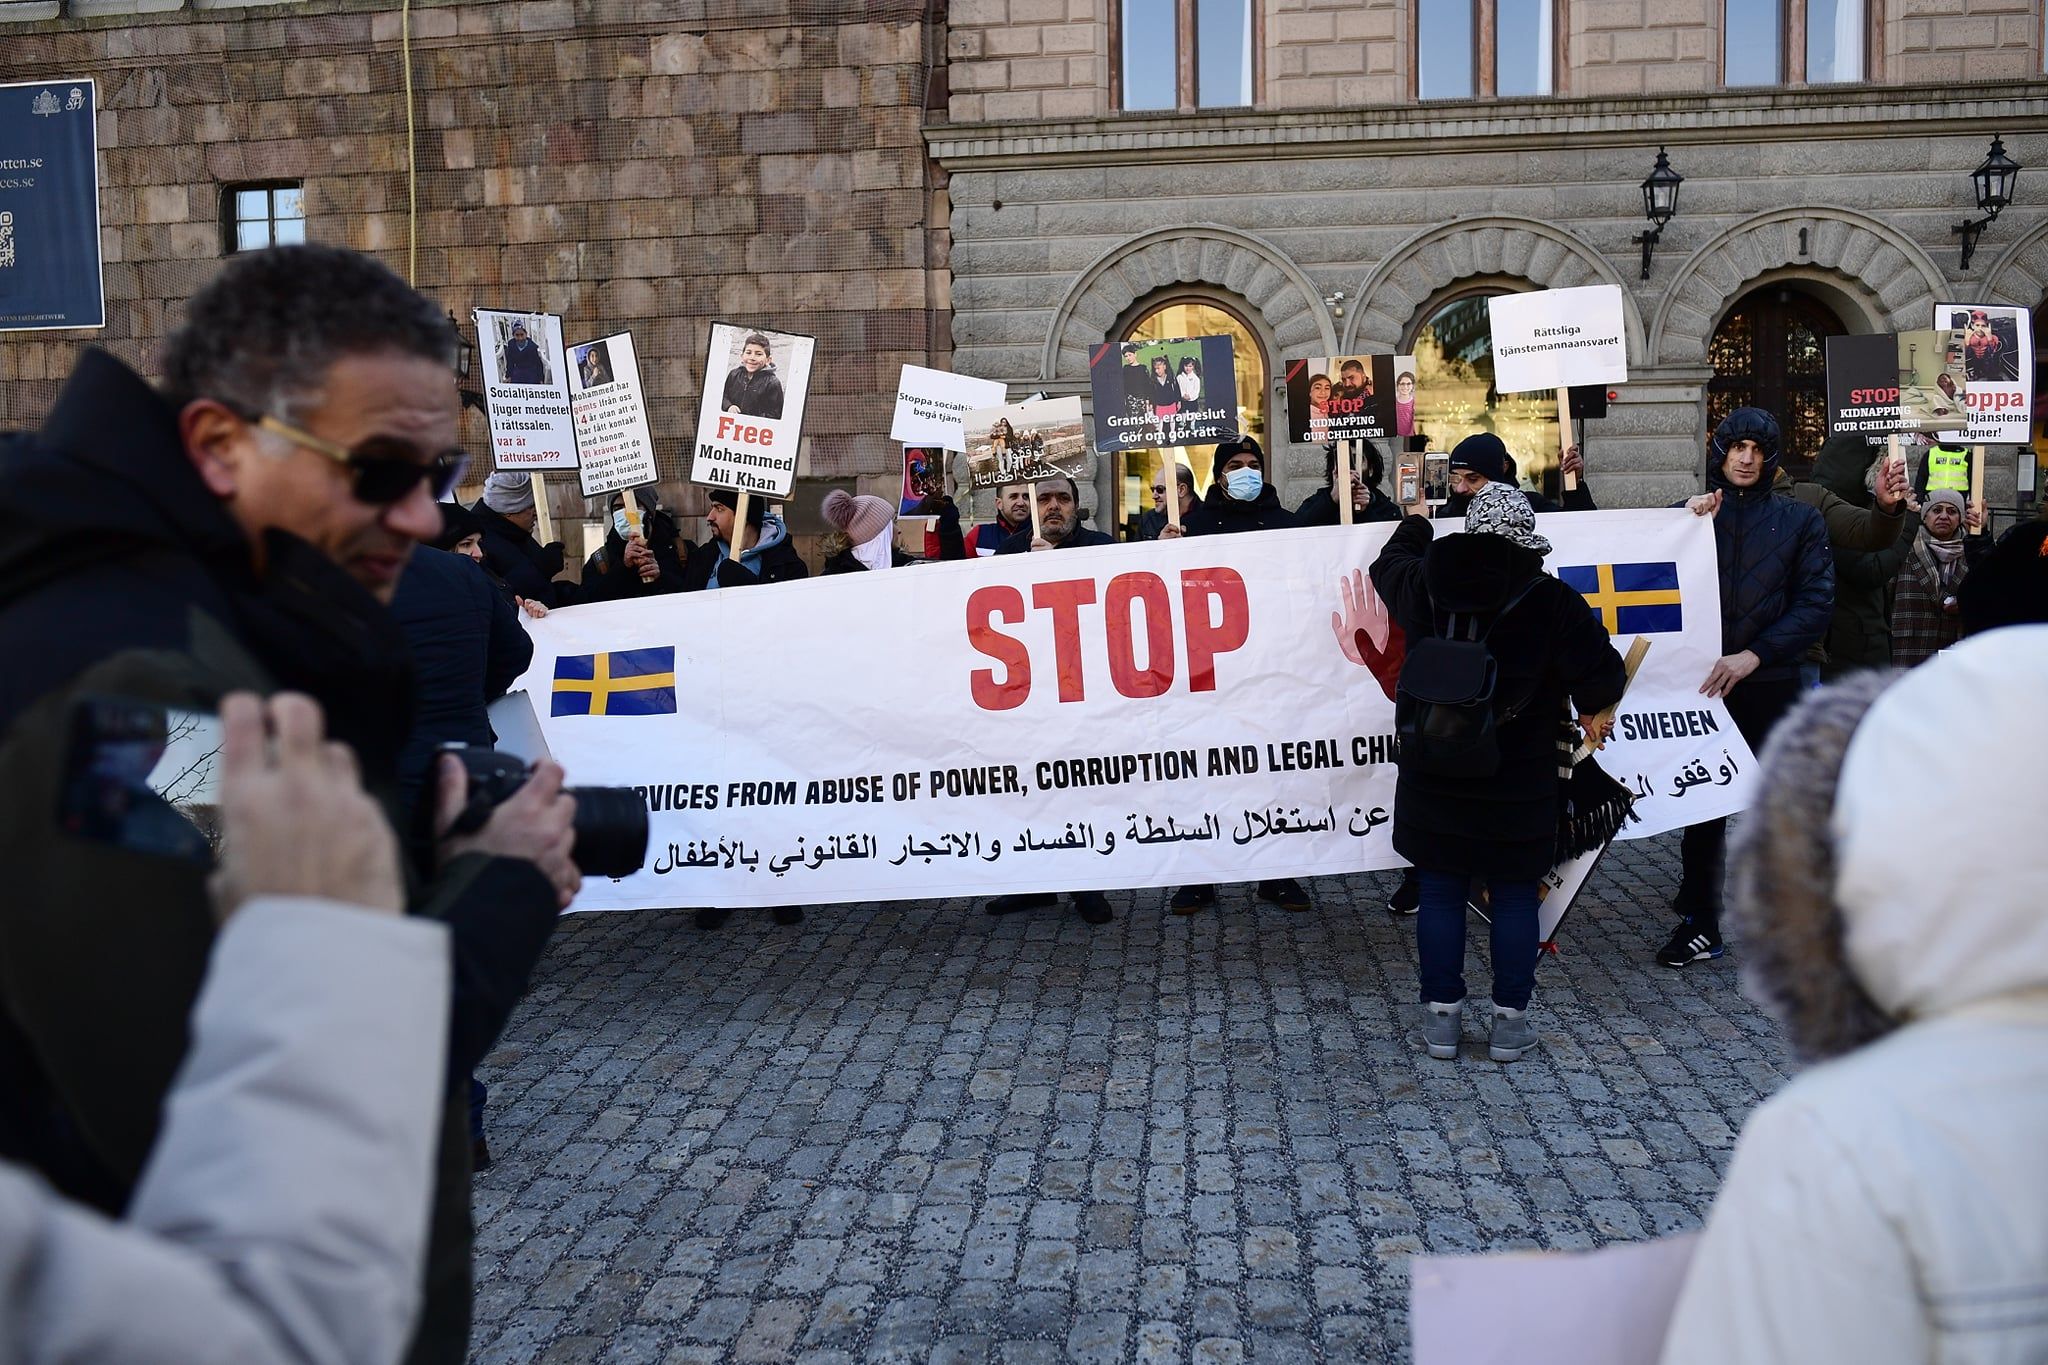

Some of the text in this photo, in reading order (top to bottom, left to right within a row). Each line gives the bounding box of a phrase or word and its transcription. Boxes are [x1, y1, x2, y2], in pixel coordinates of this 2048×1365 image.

[1798, 227, 1808, 256] 1
[1533, 325, 1581, 338] Rättsliga
[1499, 336, 1619, 357] tjänstemannaansvaret
[490, 387, 562, 401] Socialtjänsten
[571, 382, 629, 402] Mohammed har
[619, 393, 633, 402] oss
[899, 392, 933, 406] Stoppa
[1850, 387, 1900, 404] STOP
[492, 403, 570, 417] ljuger medvetet
[581, 414, 588, 425] 4
[599, 409, 616, 419] utan
[618, 405, 629, 415] att
[630, 403, 638, 412] vi
[913, 407, 937, 420] begå
[1319, 398, 1364, 414] STOP
[1839, 405, 1912, 418] KIDNAPPING
[494, 419, 554, 431] i rättssalen.
[578, 427, 592, 436] har
[609, 415, 638, 428] kontakt
[1107, 408, 1226, 427] Granska era beslut
[1309, 415, 1375, 428] KIDNAPPING
[1833, 418, 1921, 432] OUR CHILDREN!
[496, 435, 526, 446] var är
[716, 416, 774, 446] Free
[1118, 425, 1218, 444] Gör om gör rätt
[1303, 428, 1384, 441] OUR CHILDREN!
[580, 437, 598, 447] med
[582, 449, 592, 459] Vi
[619, 441, 630, 450] att
[631, 439, 641, 447] de
[499, 451, 560, 463] rättvisan???
[585, 450, 642, 470] skapar kontakt
[699, 443, 793, 472] Mohammed
[587, 469, 615, 481] mellan
[589, 472, 649, 493] och Mohammed
[708, 467, 777, 491] Ali Khan
[966, 566, 1250, 711] STOP
[632, 783, 719, 812] RVICES
[726, 781, 797, 808] FROM
[804, 775, 884, 805] ABUSE
[893, 772, 921, 802] OF
[929, 764, 1028, 797] POWER,
[1036, 749, 1197, 791] CORRUPTION
[1206, 744, 1259, 777] AND
[1267, 737, 1344, 772] LEGAL
[1620, 710, 1719, 741] SWEDEN
[1125, 812, 1220, 844] السلطة
[1233, 805, 1336, 845] استغلال
[1349, 806, 1390, 837] عن
[653, 835, 759, 875] بالأطفال
[768, 833, 877, 877] القانوني
